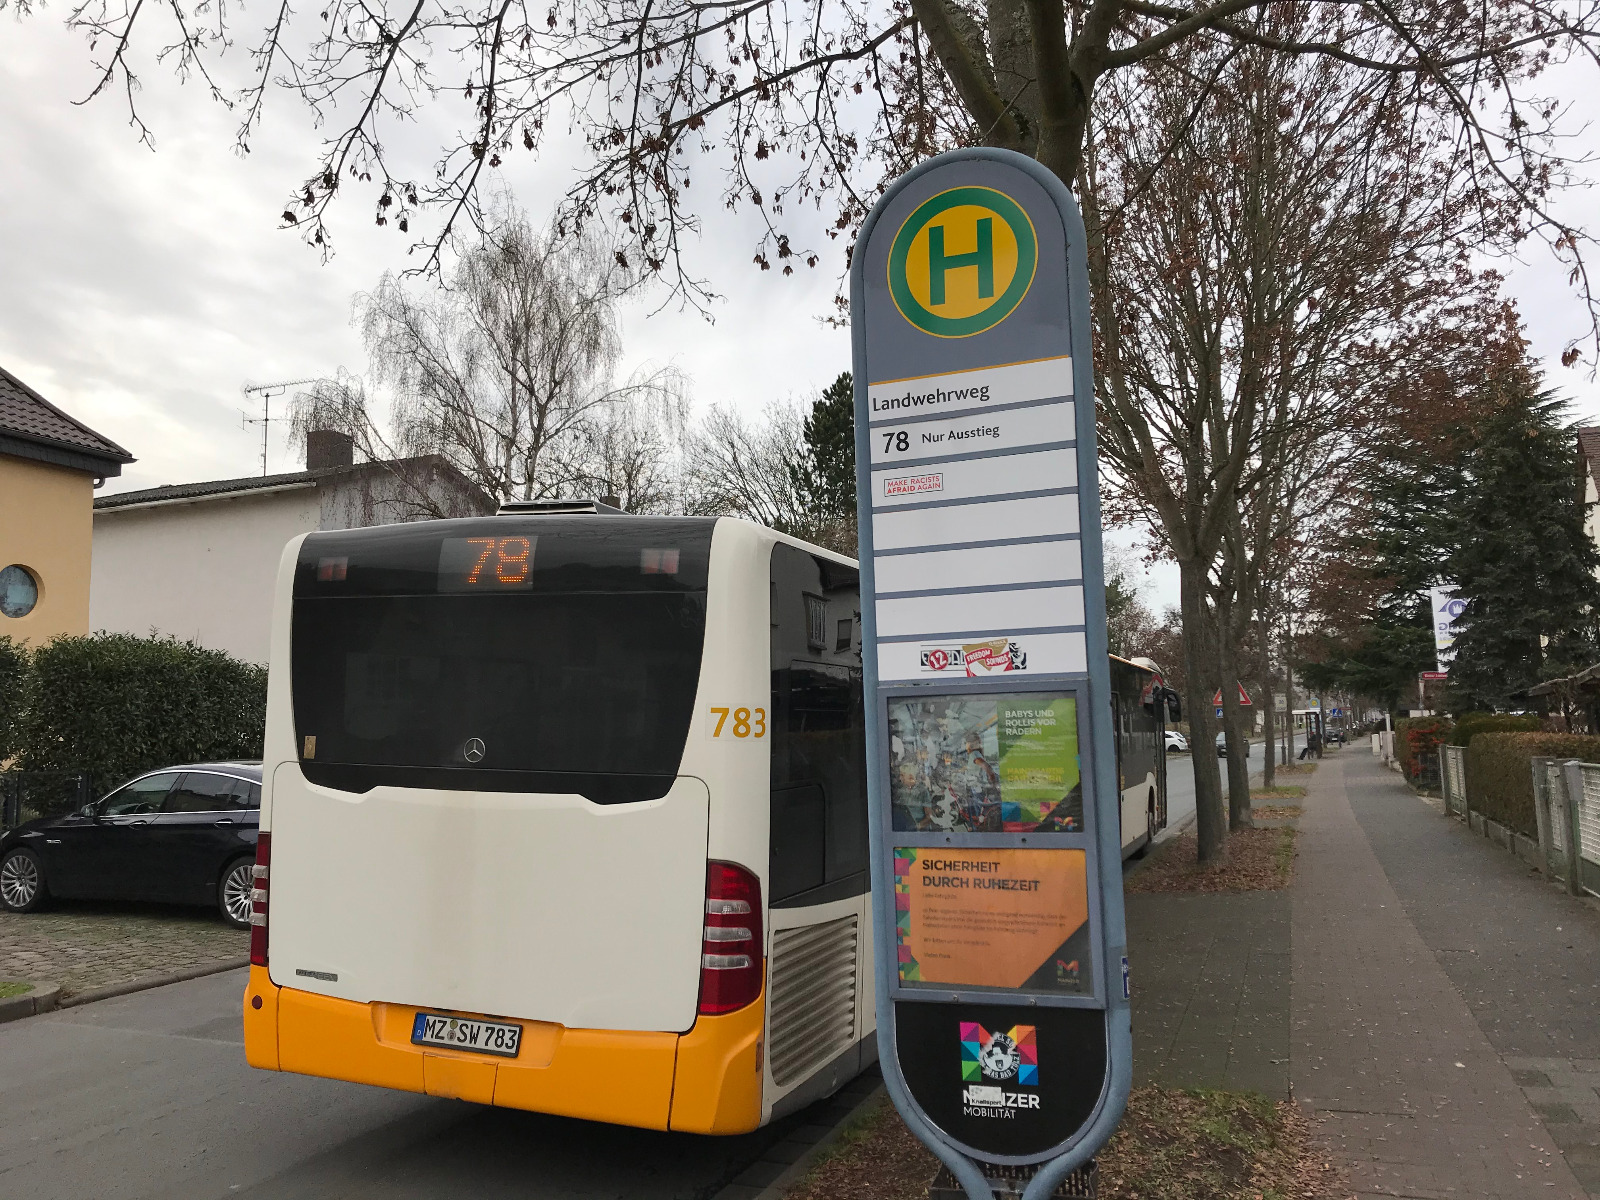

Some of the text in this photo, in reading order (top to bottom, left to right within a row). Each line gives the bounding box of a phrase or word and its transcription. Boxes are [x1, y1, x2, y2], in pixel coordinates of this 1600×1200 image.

[929, 217, 994, 306] H
[873, 385, 990, 411] Landwehrweg
[882, 426, 1000, 453] 78 Nur Ausstieg
[887, 482, 941, 494] AFRAID AGAIN
[888, 475, 940, 487] MAKE RACISTS
[467, 537, 530, 583] 78
[930, 651, 947, 668] 12
[966, 649, 991, 663] FREEDOM
[986, 654, 1009, 666] SOUNDS
[1005, 709, 1055, 718] BABYS UND
[710, 707, 766, 738] 783
[1006, 718, 1057, 727] ROLLIS VOR
[1006, 726, 1042, 735] RÄDERN
[922, 859, 1001, 873] SICHERHEIT
[922, 875, 1041, 892] DURCH RUHEZEIT
[423, 1018, 517, 1049] MZ SW 783
[963, 1106, 1017, 1120] MOBILITÄT
